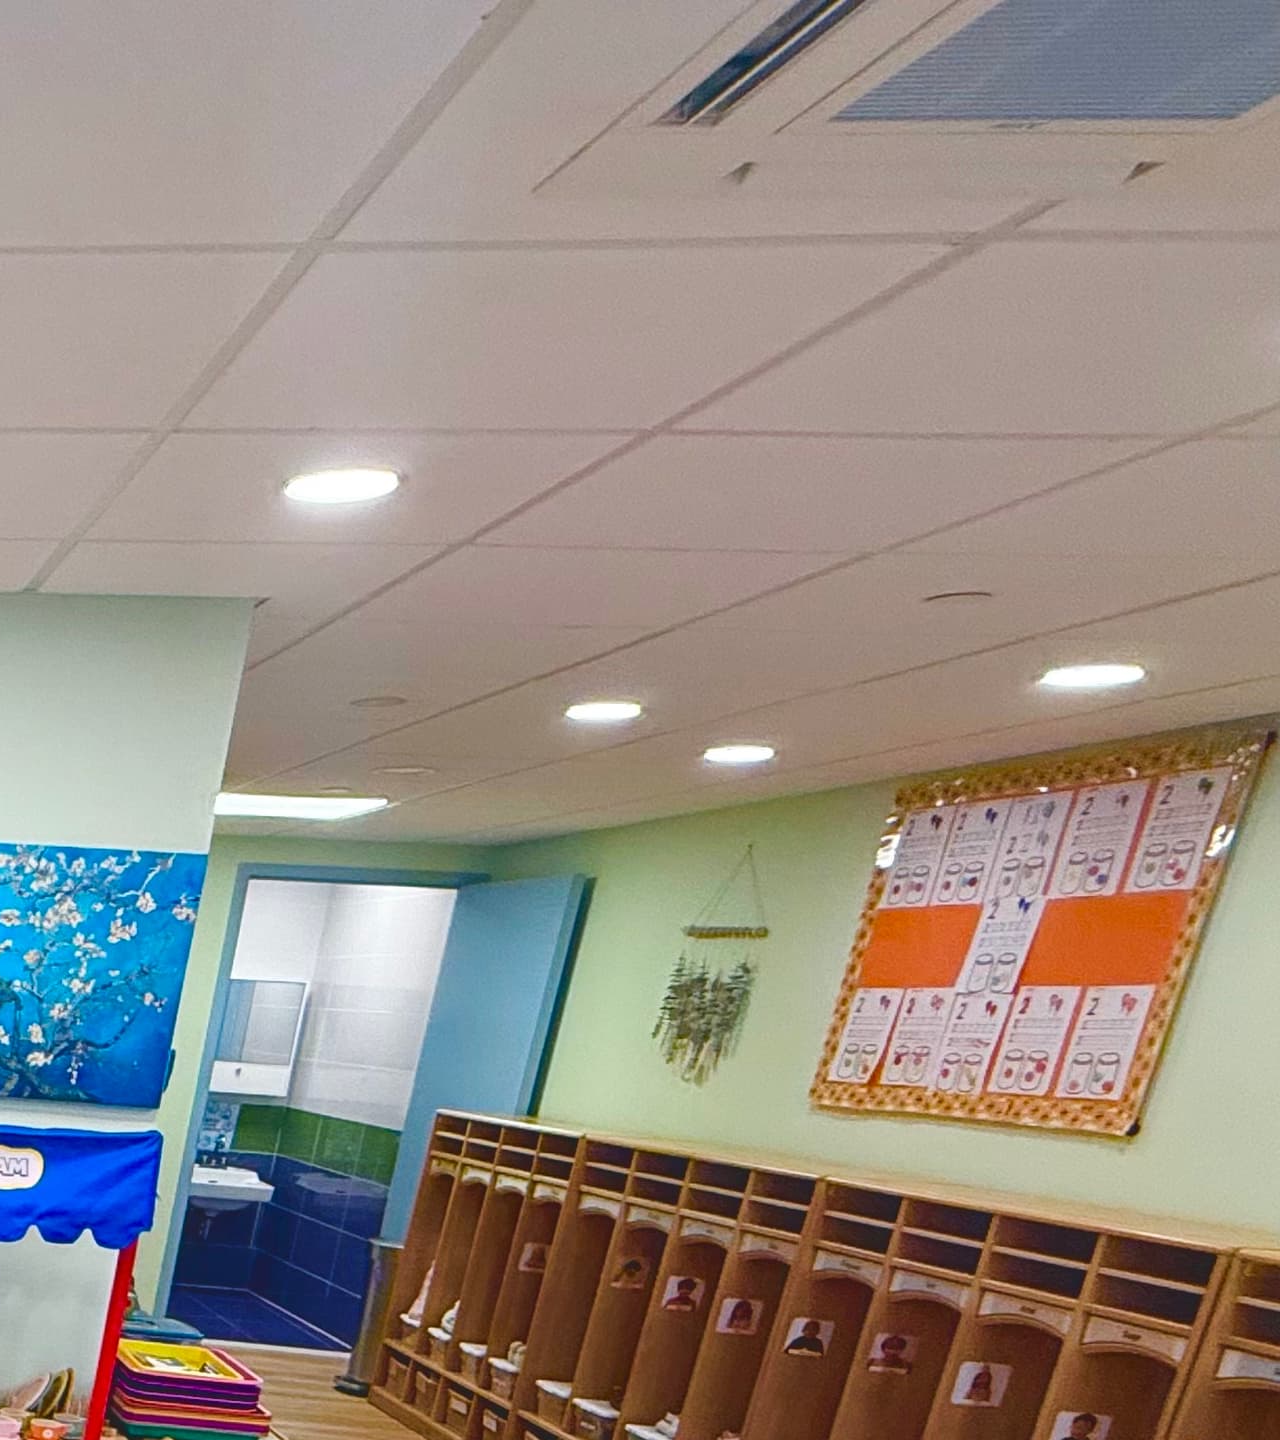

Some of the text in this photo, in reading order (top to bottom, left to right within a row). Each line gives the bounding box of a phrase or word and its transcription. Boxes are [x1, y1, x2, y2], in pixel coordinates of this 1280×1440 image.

[1160, 784, 1174, 805] 2
[1081, 796, 1095, 816] 2
[988, 900, 1000, 919] 2
[956, 1002, 968, 1020] 2
[1086, 997, 1100, 1016] 2
